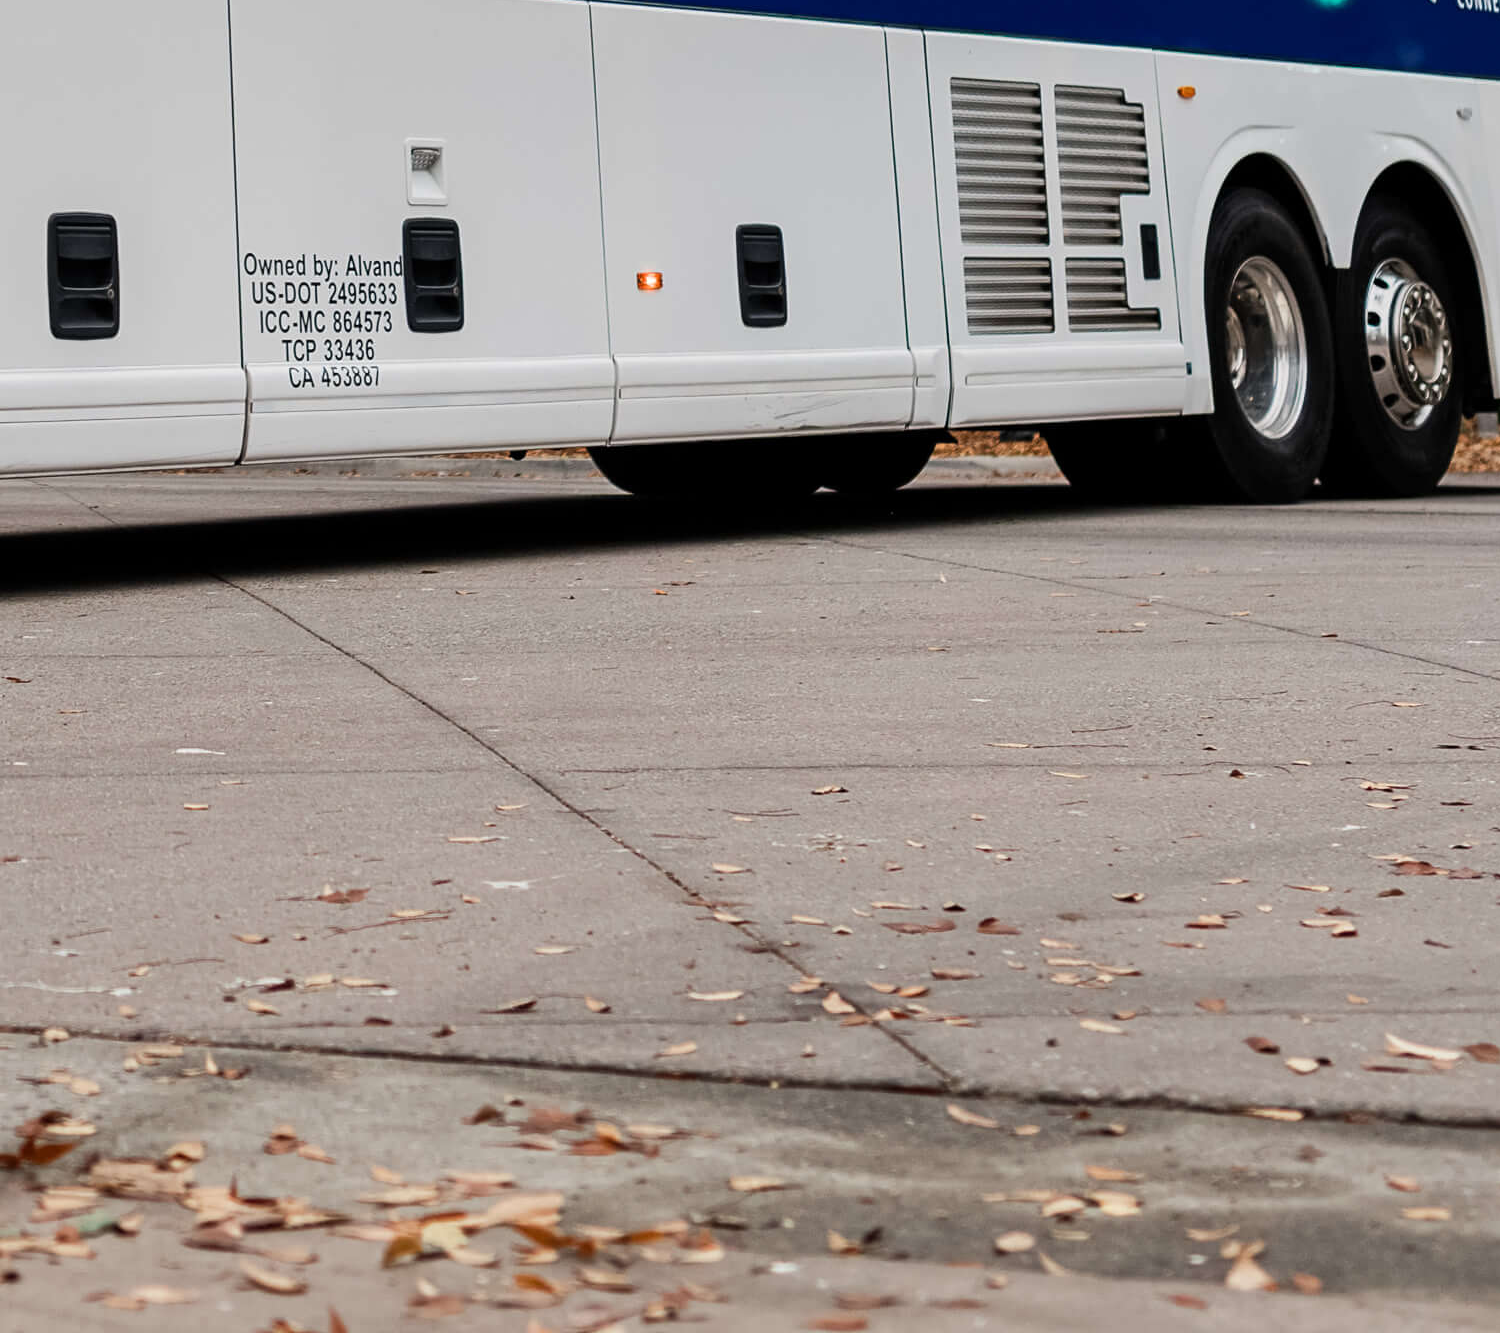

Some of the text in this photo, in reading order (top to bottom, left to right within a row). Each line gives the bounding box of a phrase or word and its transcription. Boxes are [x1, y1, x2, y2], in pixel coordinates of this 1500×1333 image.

[243, 253, 402, 282] Owned by: Alvand
[252, 282, 398, 305] US-DOT 2495633
[260, 310, 393, 333] ICC-MC 864573
[282, 339, 375, 361] TCP 33436
[288, 366, 380, 388] CA 453887
